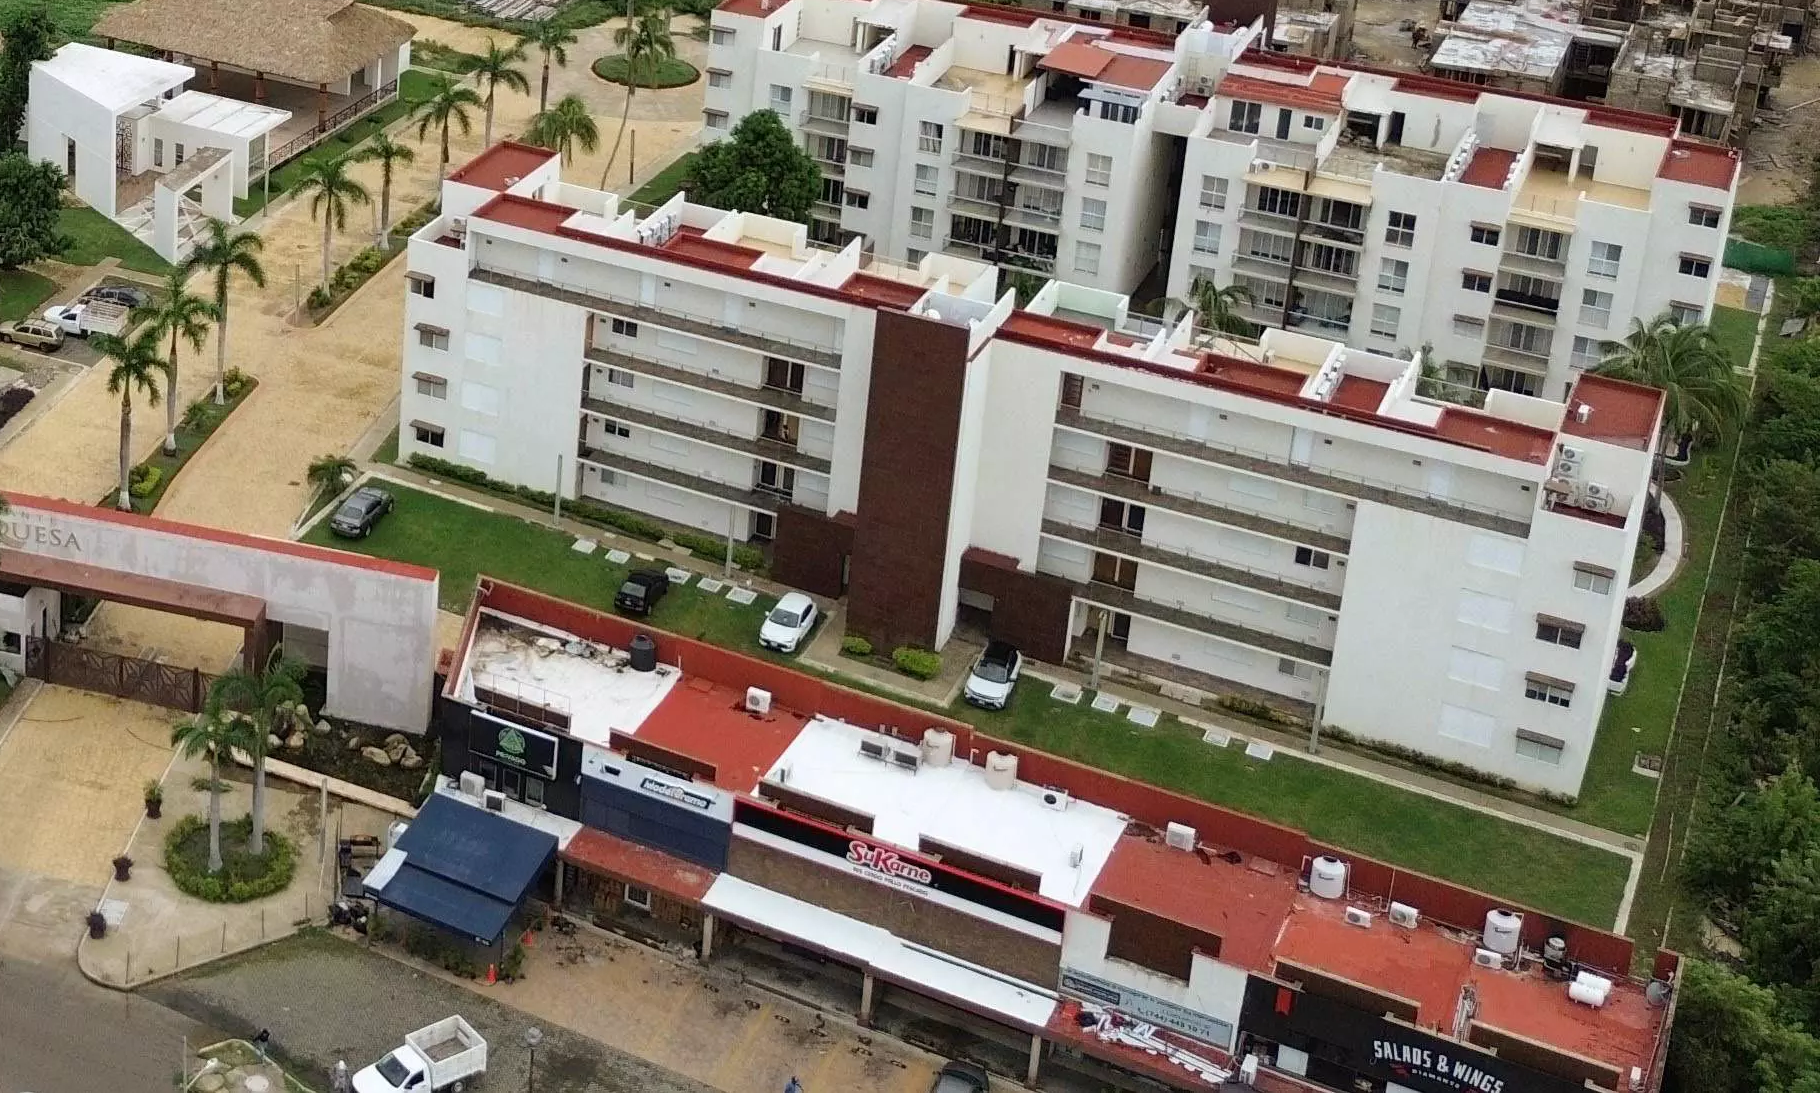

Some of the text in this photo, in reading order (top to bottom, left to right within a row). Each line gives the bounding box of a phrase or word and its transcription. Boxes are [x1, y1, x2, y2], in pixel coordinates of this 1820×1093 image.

[846, 841, 932, 884] SuKarne
[1373, 1040, 1504, 1093] SALADS & WINGS
